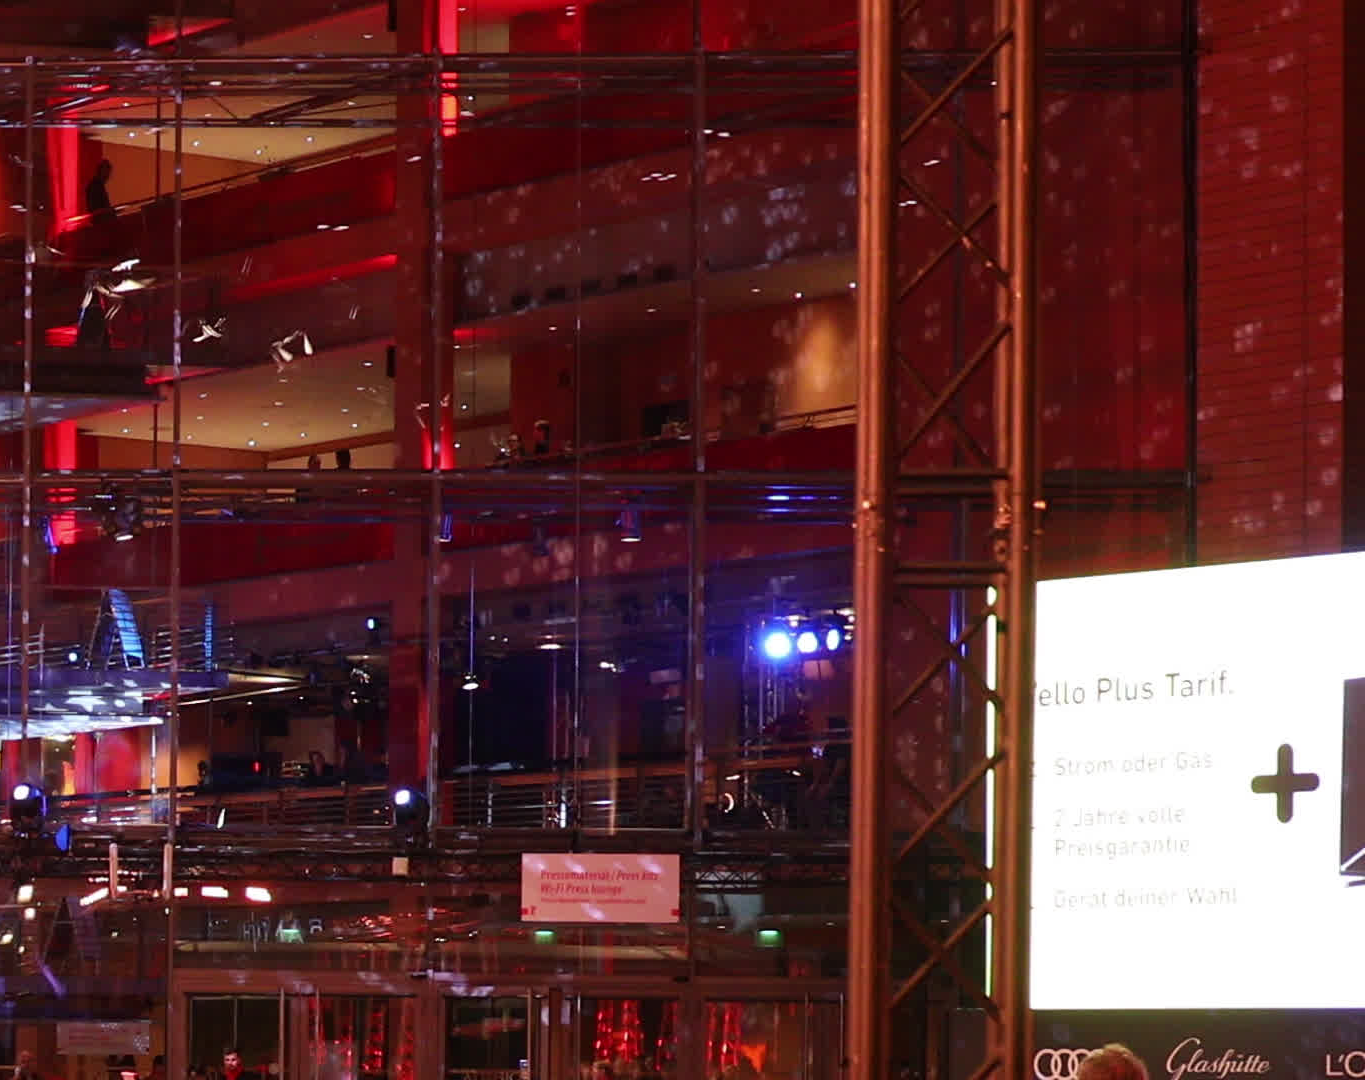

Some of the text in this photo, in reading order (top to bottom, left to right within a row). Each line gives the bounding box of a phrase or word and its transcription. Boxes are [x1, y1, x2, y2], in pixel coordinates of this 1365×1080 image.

[1036, 668, 1236, 707] ello Plus Tarif.
[1053, 750, 1214, 777] Strom oder Gas
[1072, 807, 1127, 827] Jahre
[1137, 805, 1186, 825] volle
[1054, 836, 1191, 861] Preisgarantie
[1113, 887, 1178, 907] deiner
